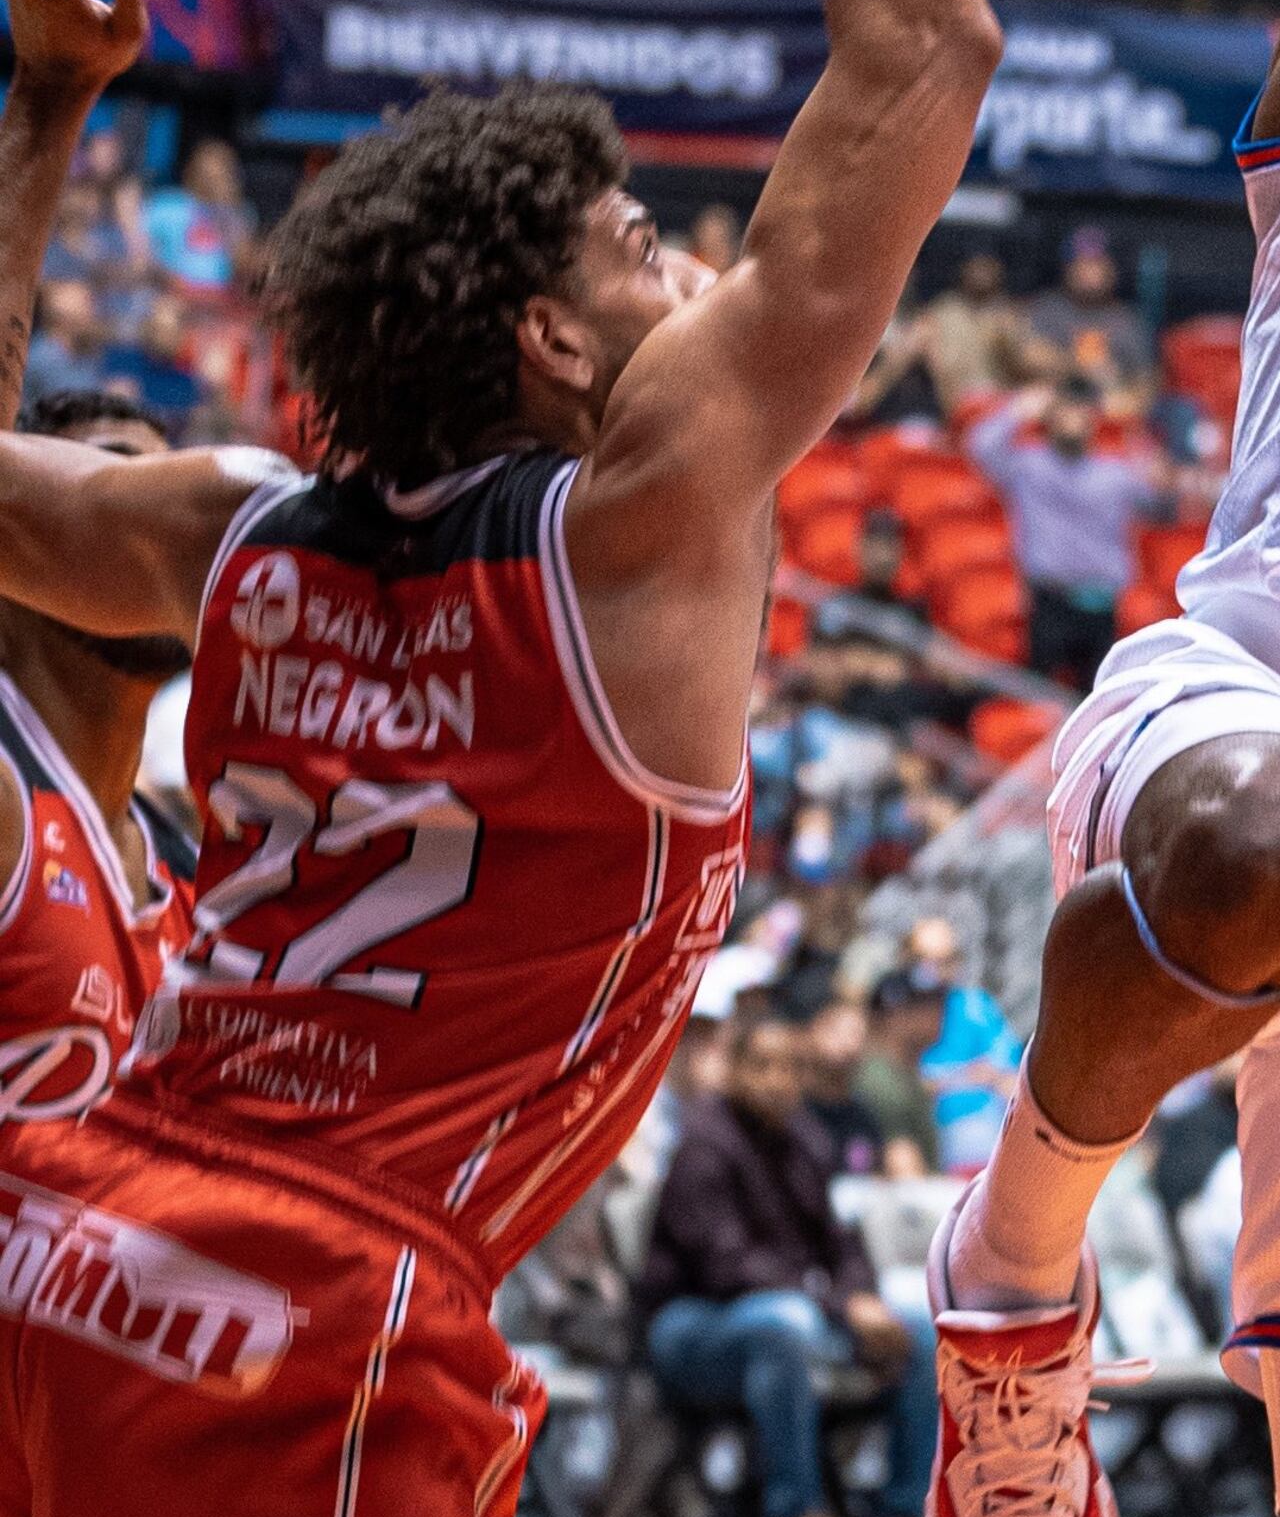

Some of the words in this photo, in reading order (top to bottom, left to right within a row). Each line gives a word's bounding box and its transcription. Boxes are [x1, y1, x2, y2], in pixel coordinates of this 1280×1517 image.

[326, 4, 782, 97] BIENVENIDOS
[391, 600, 474, 670] LAS
[232, 649, 476, 752] NEGRON
[193, 759, 485, 1010] 22
